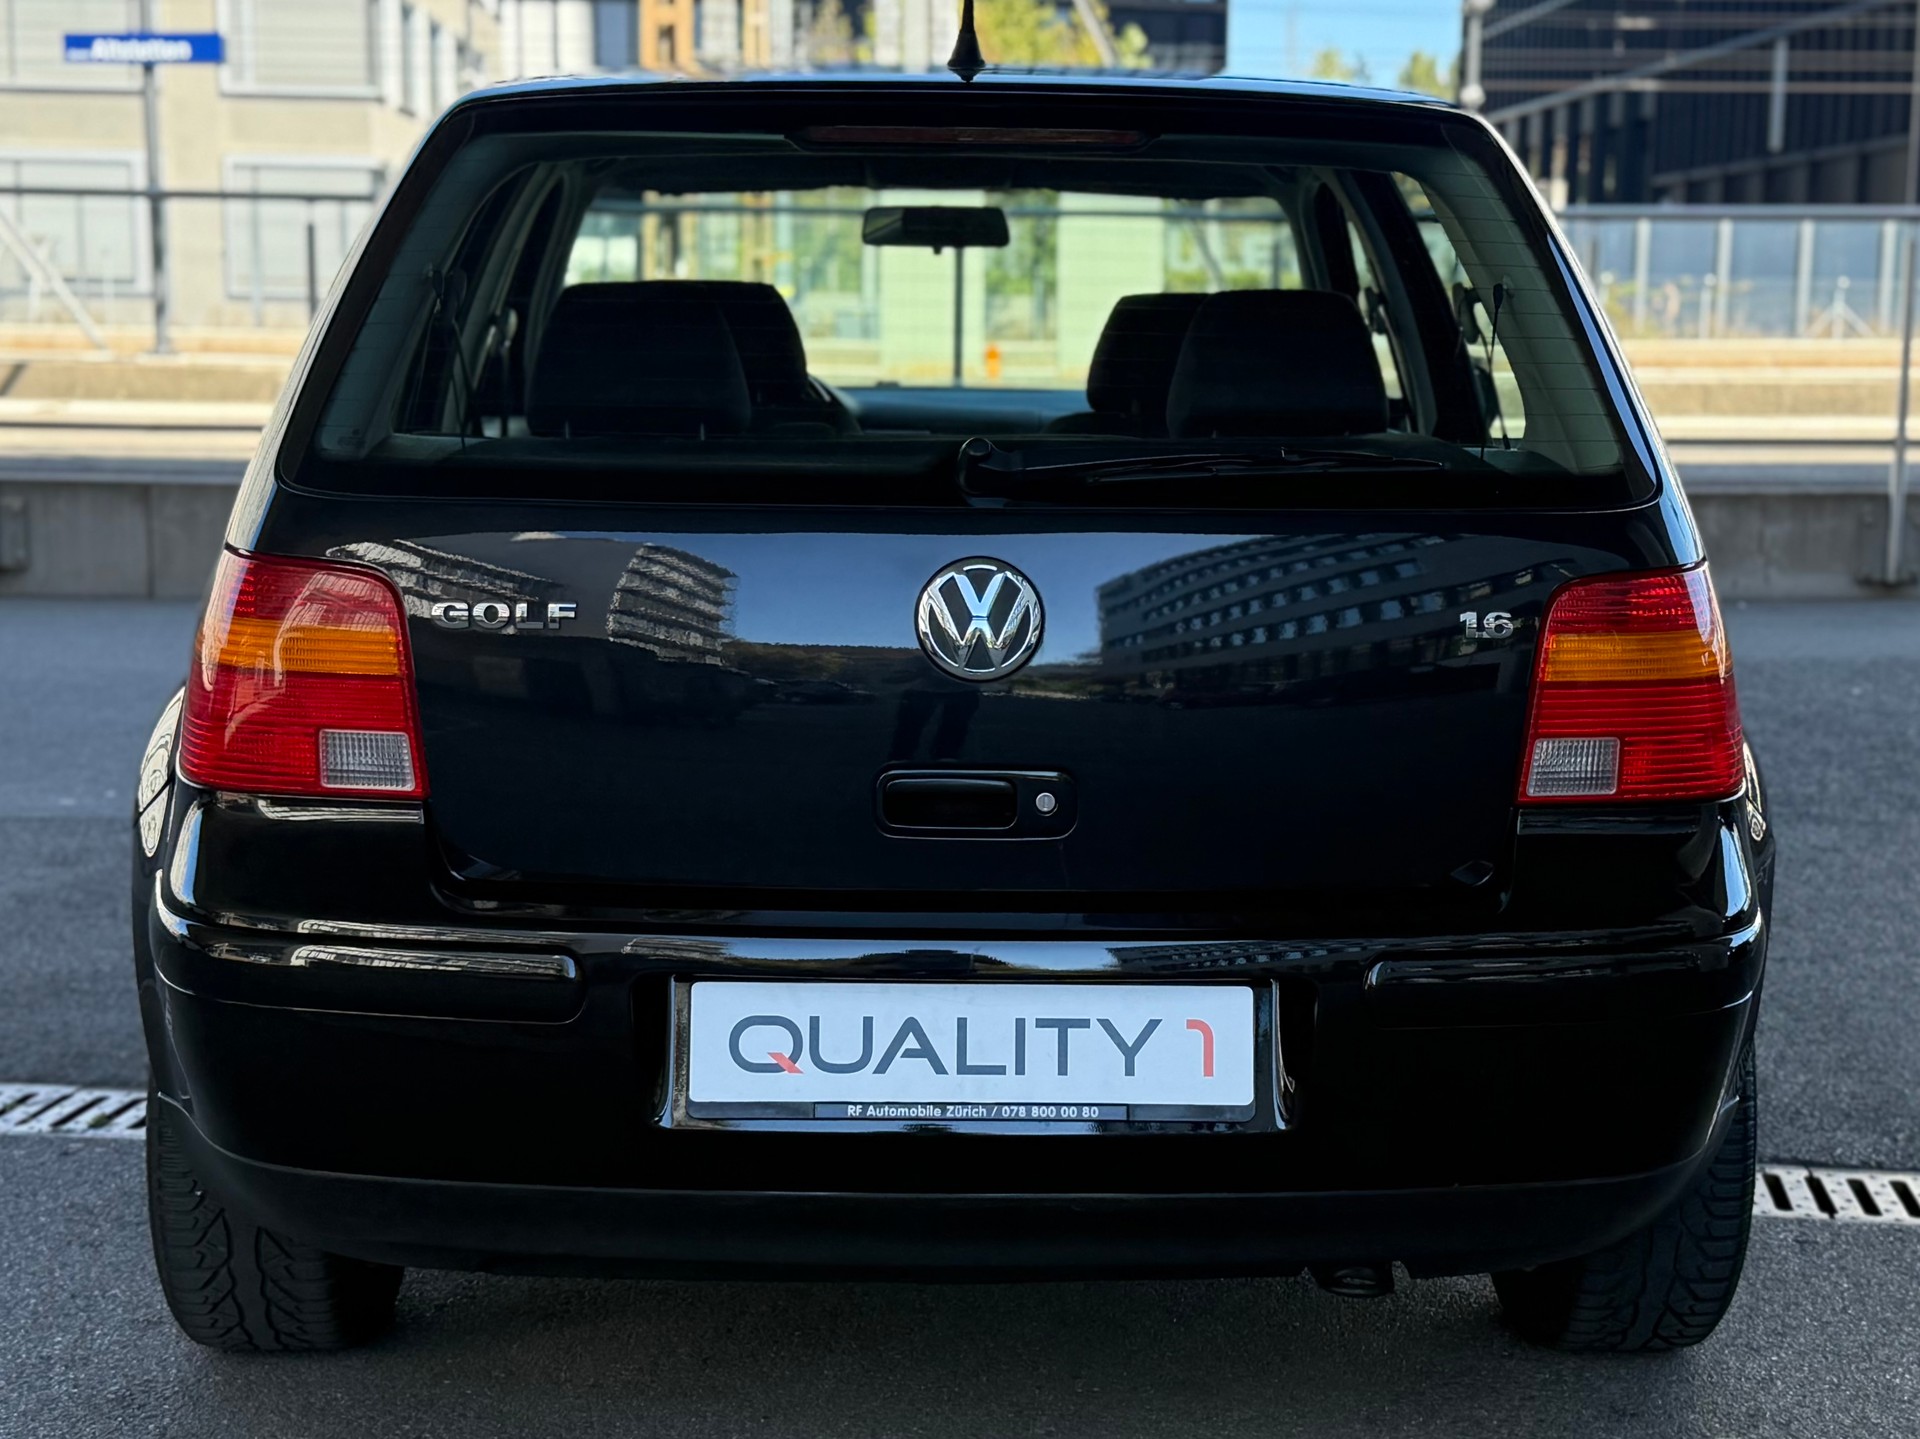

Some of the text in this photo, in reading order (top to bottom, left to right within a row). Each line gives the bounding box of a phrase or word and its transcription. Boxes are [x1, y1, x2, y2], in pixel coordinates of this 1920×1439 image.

[431, 602, 577, 629] GOLF
[728, 1014, 1215, 1078] QUALITY 1
[847, 1105, 863, 1117] RF
[866, 1105, 942, 1117] Automobile
[946, 1105, 987, 1117] Zürich
[1002, 1105, 1026, 1117] 078
[1031, 1106, 1056, 1118] 800
[1060, 1106, 1078, 1118] 00
[1082, 1106, 1099, 1118] 80
